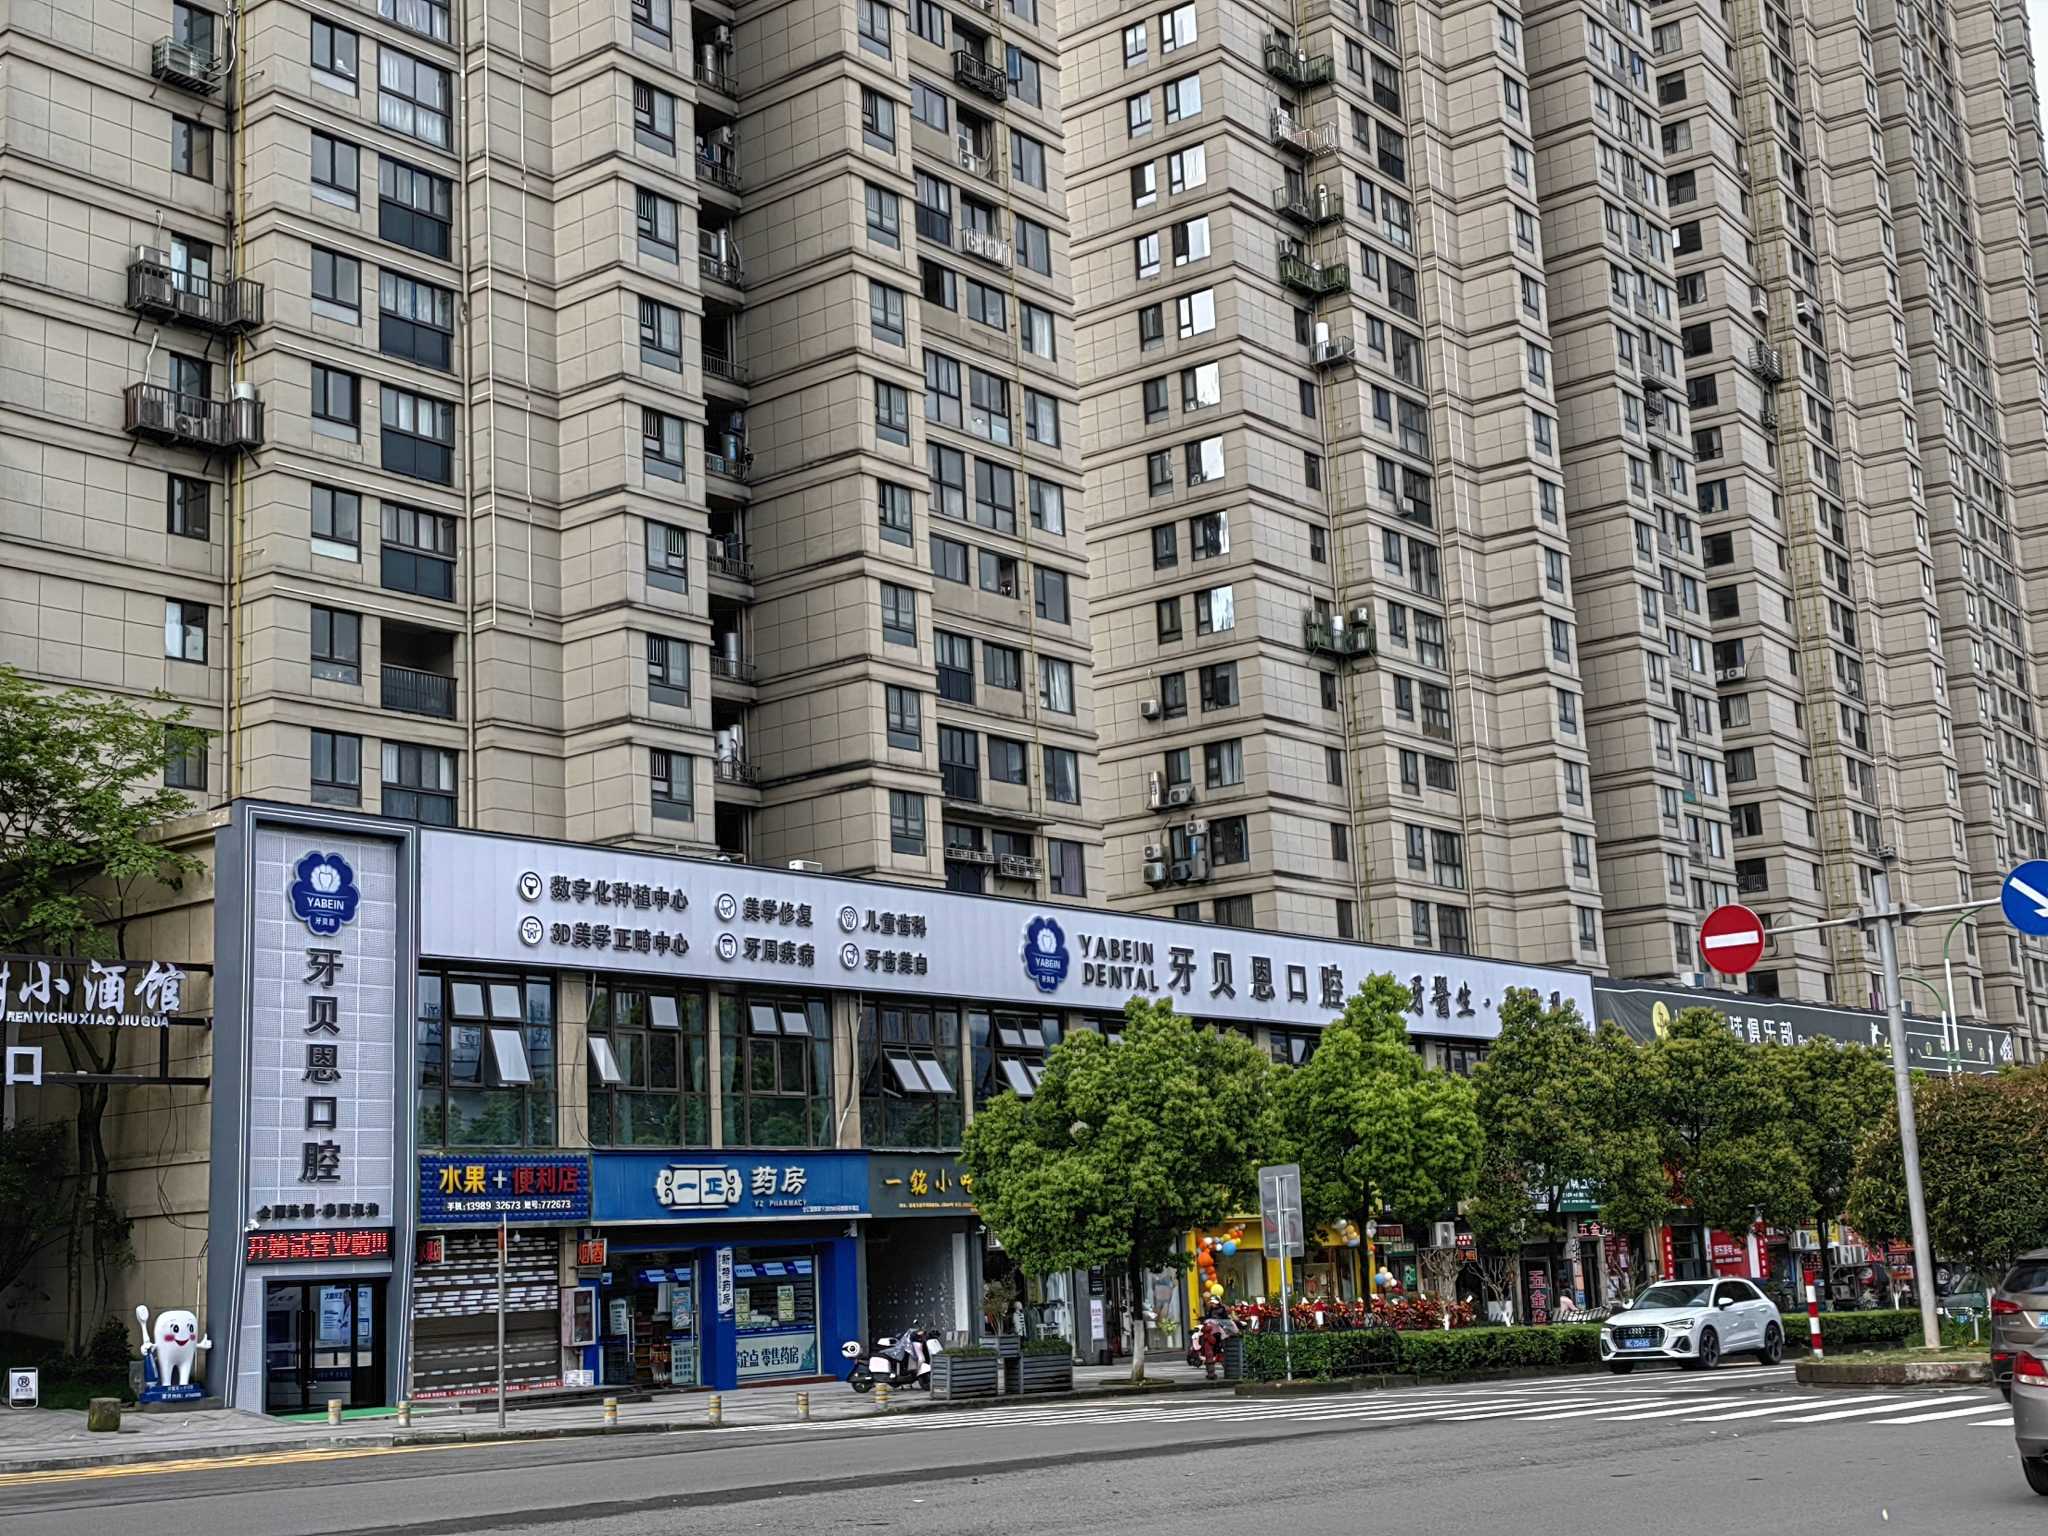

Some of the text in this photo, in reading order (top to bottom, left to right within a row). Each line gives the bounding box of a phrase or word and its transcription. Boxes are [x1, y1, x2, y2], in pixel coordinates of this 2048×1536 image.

[306, 896, 345, 911] YABEIN
[550, 875, 689, 912] 数字化种植中心
[742, 896, 814, 929] 美学修复
[862, 909, 927, 939] 儿童齿科
[550, 922, 690, 957] 3D美学正畸中心
[742, 936, 816, 969] 牙周疾病
[1077, 934, 1154, 966] YABEIN
[862, 948, 929, 976] 牙齿美白
[1034, 956, 1062, 970] YABEIN
[1082, 961, 1160, 993] DENTAL
[1167, 945, 1346, 1011] 牙贝恩口腔
[0, 959, 187, 1020] 小酒馆
[1727, 1015, 1795, 1047] 球俱乐部
[299, 946, 345, 1184] 牙贝恩口腔
[676, 1176, 725, 1196] 一正
[751, 1165, 808, 1196] 药房
[769, 1199, 808, 1208] PHARMACY
[761, 1344, 799, 1366] 零售药房
